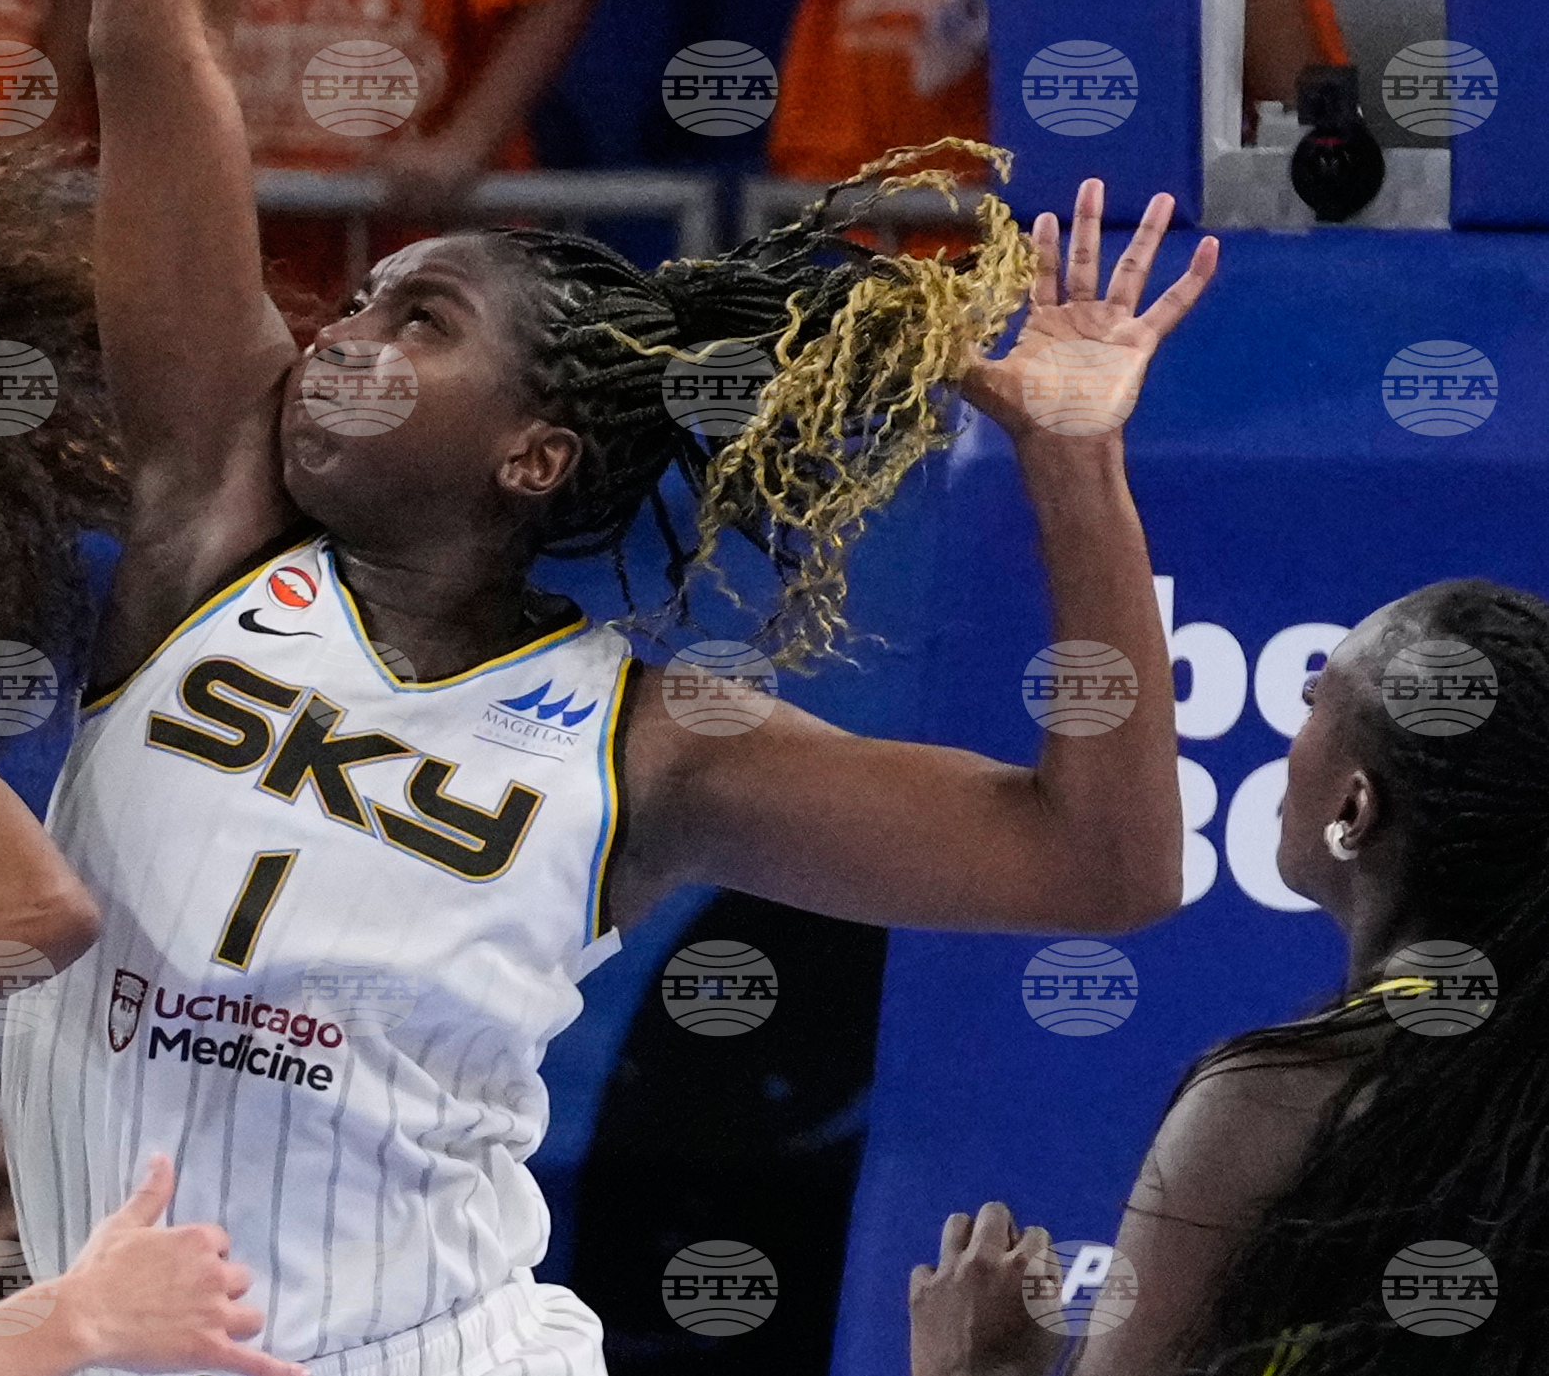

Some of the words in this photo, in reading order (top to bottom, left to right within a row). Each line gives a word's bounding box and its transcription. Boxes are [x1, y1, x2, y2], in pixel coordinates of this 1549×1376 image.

[482, 710, 575, 746] MAGELLAN
[145, 655, 547, 884] SKY
[210, 848, 301, 975] 1
[155, 987, 344, 1048] UChicago
[148, 1026, 333, 1091] Medicine
